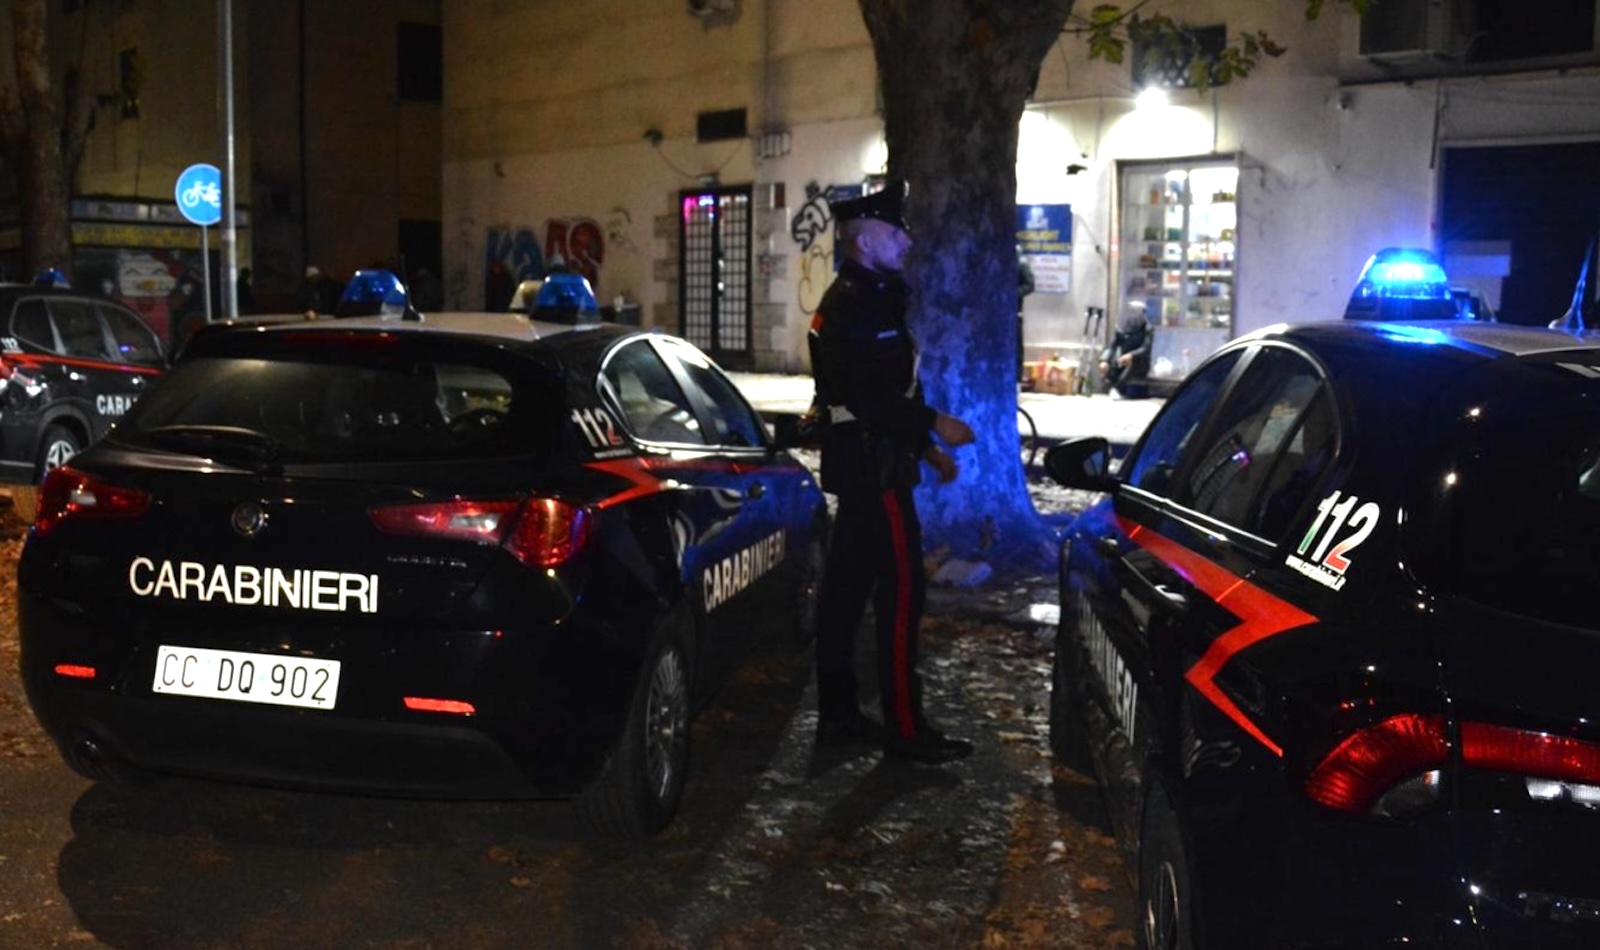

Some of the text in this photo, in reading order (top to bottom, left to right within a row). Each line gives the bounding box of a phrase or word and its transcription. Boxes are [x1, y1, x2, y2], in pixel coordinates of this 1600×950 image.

[96, 394, 138, 415] CARA
[571, 407, 624, 447] 112
[1297, 489, 1380, 574] 112
[129, 557, 379, 613] CARABINIERI
[703, 528, 786, 613] CARABINIERI
[162, 653, 330, 702] CC DQ 902
